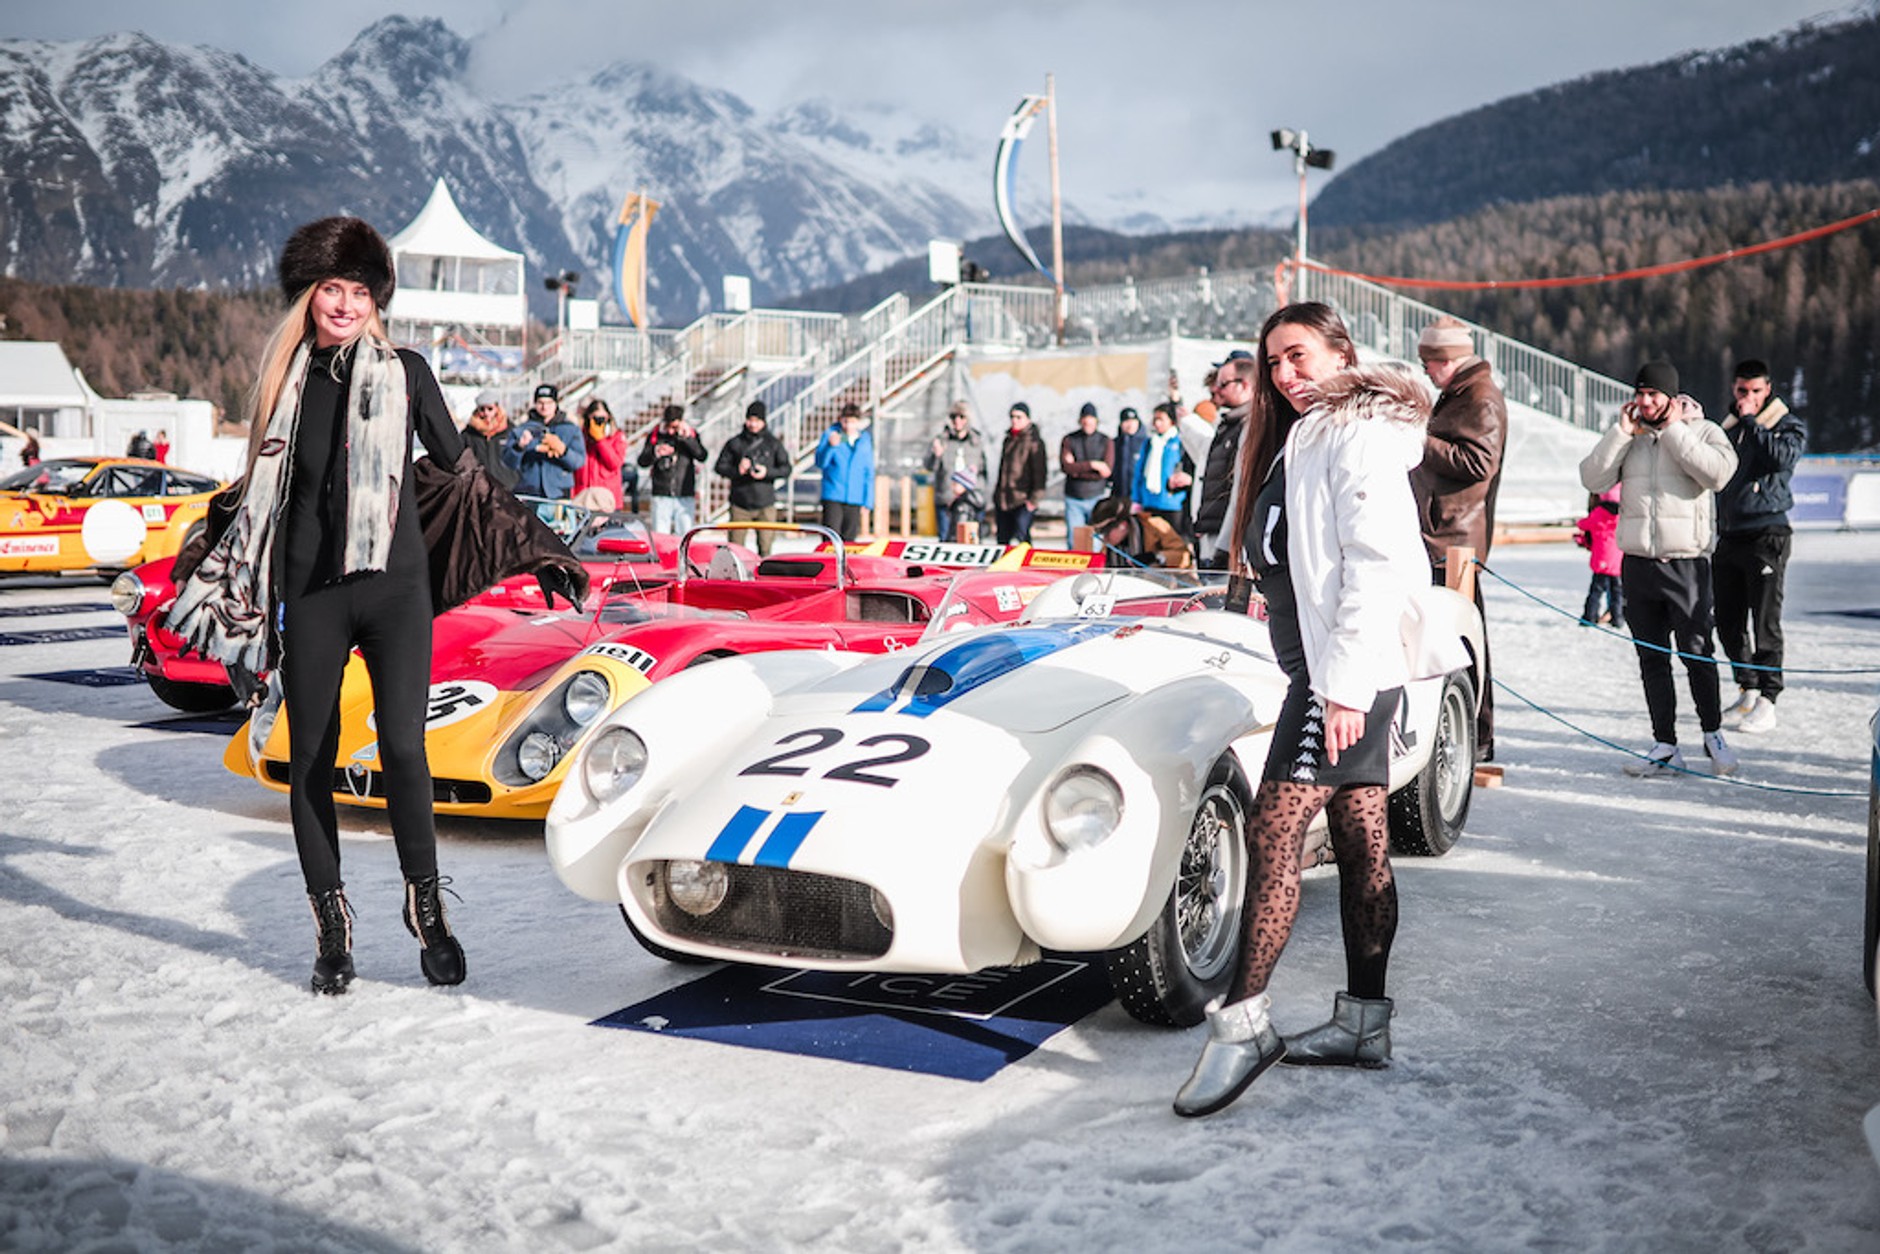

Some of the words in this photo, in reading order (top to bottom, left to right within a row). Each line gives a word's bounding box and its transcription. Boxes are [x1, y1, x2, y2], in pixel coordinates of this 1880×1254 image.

[903, 545, 1002, 565] Shell
[1085, 604, 1107, 616] 63
[737, 727, 932, 788] 22
[848, 973, 988, 1000] ICE
